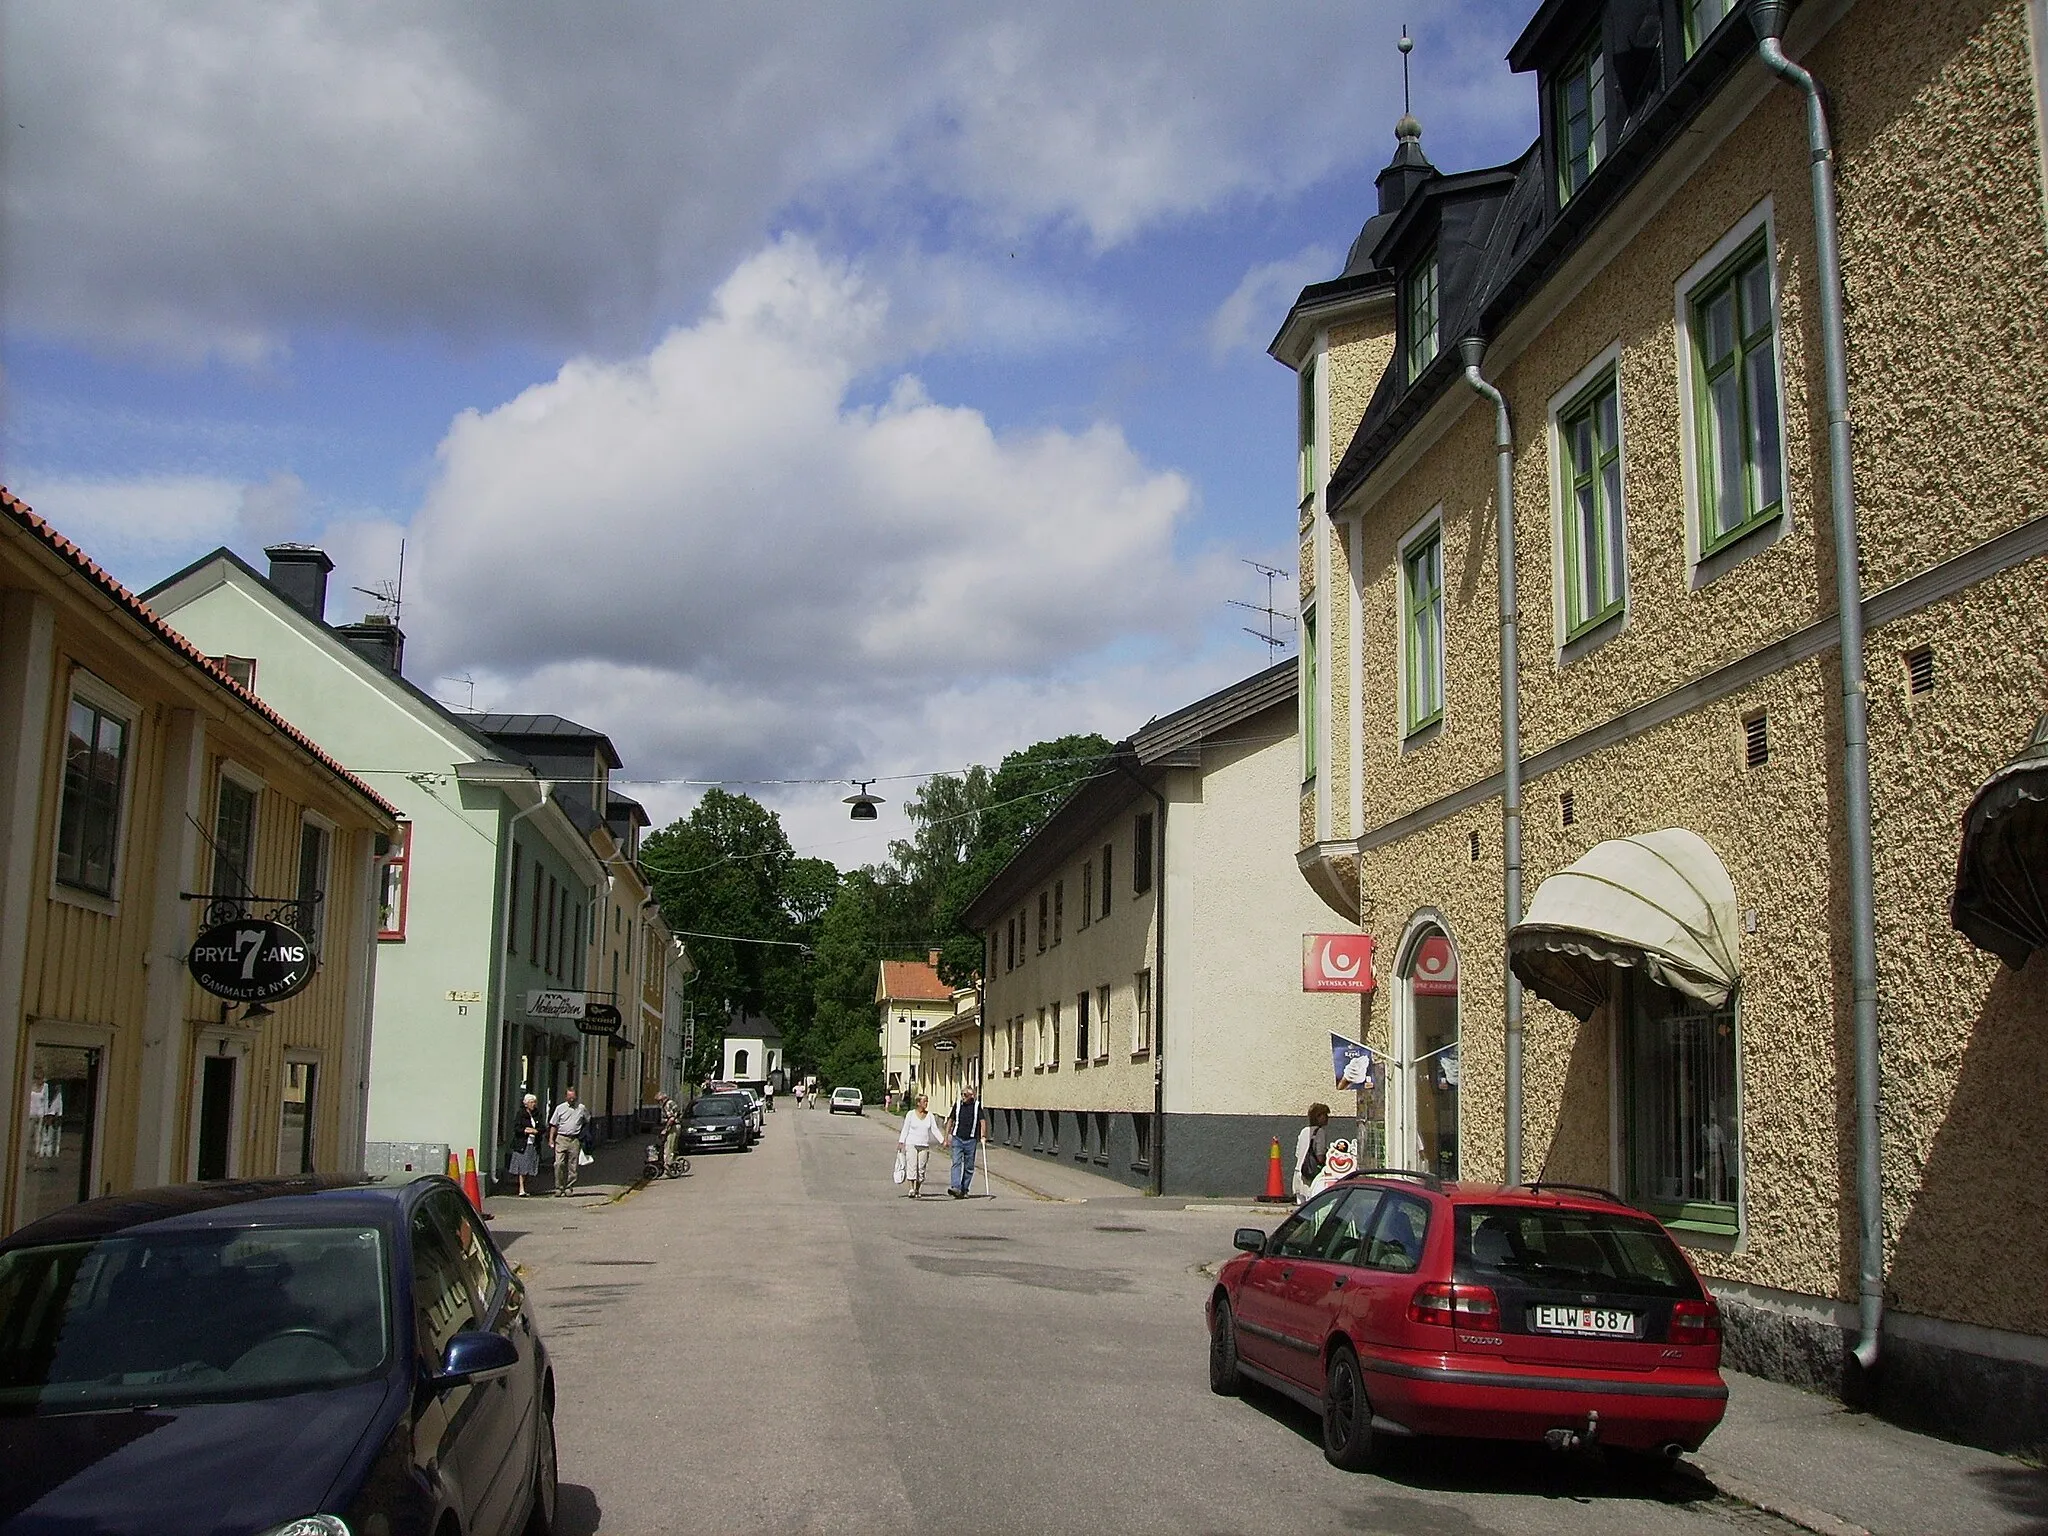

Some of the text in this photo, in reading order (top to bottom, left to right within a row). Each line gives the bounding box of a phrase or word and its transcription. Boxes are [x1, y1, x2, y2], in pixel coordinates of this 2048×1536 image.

[200, 971, 298, 998] GAMMALT & NYTT
[1540, 1307, 1631, 1331] ELW 687
[1460, 1335, 1503, 1345] VOLVO
